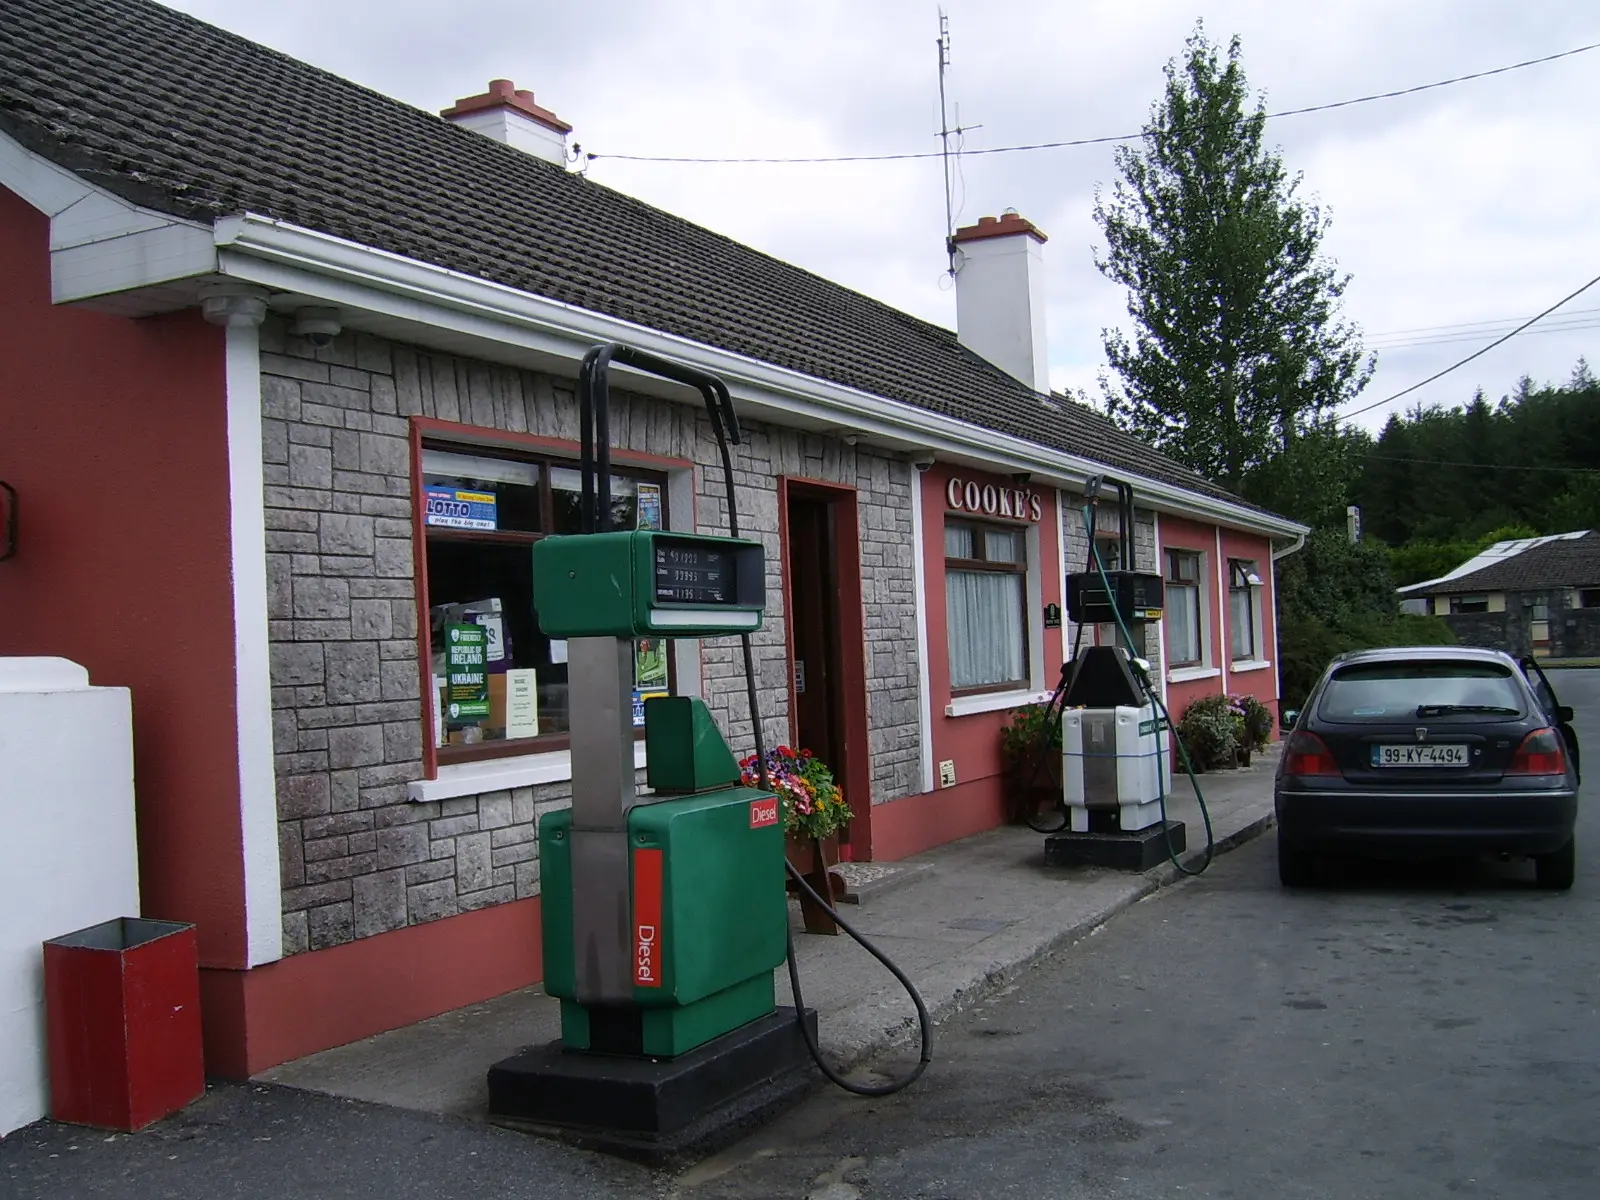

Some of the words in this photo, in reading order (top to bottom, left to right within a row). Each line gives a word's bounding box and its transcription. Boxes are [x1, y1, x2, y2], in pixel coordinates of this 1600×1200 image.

[947, 477, 1042, 521] COOKE'S
[426, 499, 470, 517] LOTTO
[451, 646, 475, 654] REPUBLIC
[475, 646, 482, 654] OF
[451, 654, 483, 665] IRELAND
[452, 673, 484, 685] UKRAINE
[1384, 748, 1462, 763] 99-KY-4494
[752, 804, 778, 823] Diesel
[638, 925, 655, 982] Diesel
